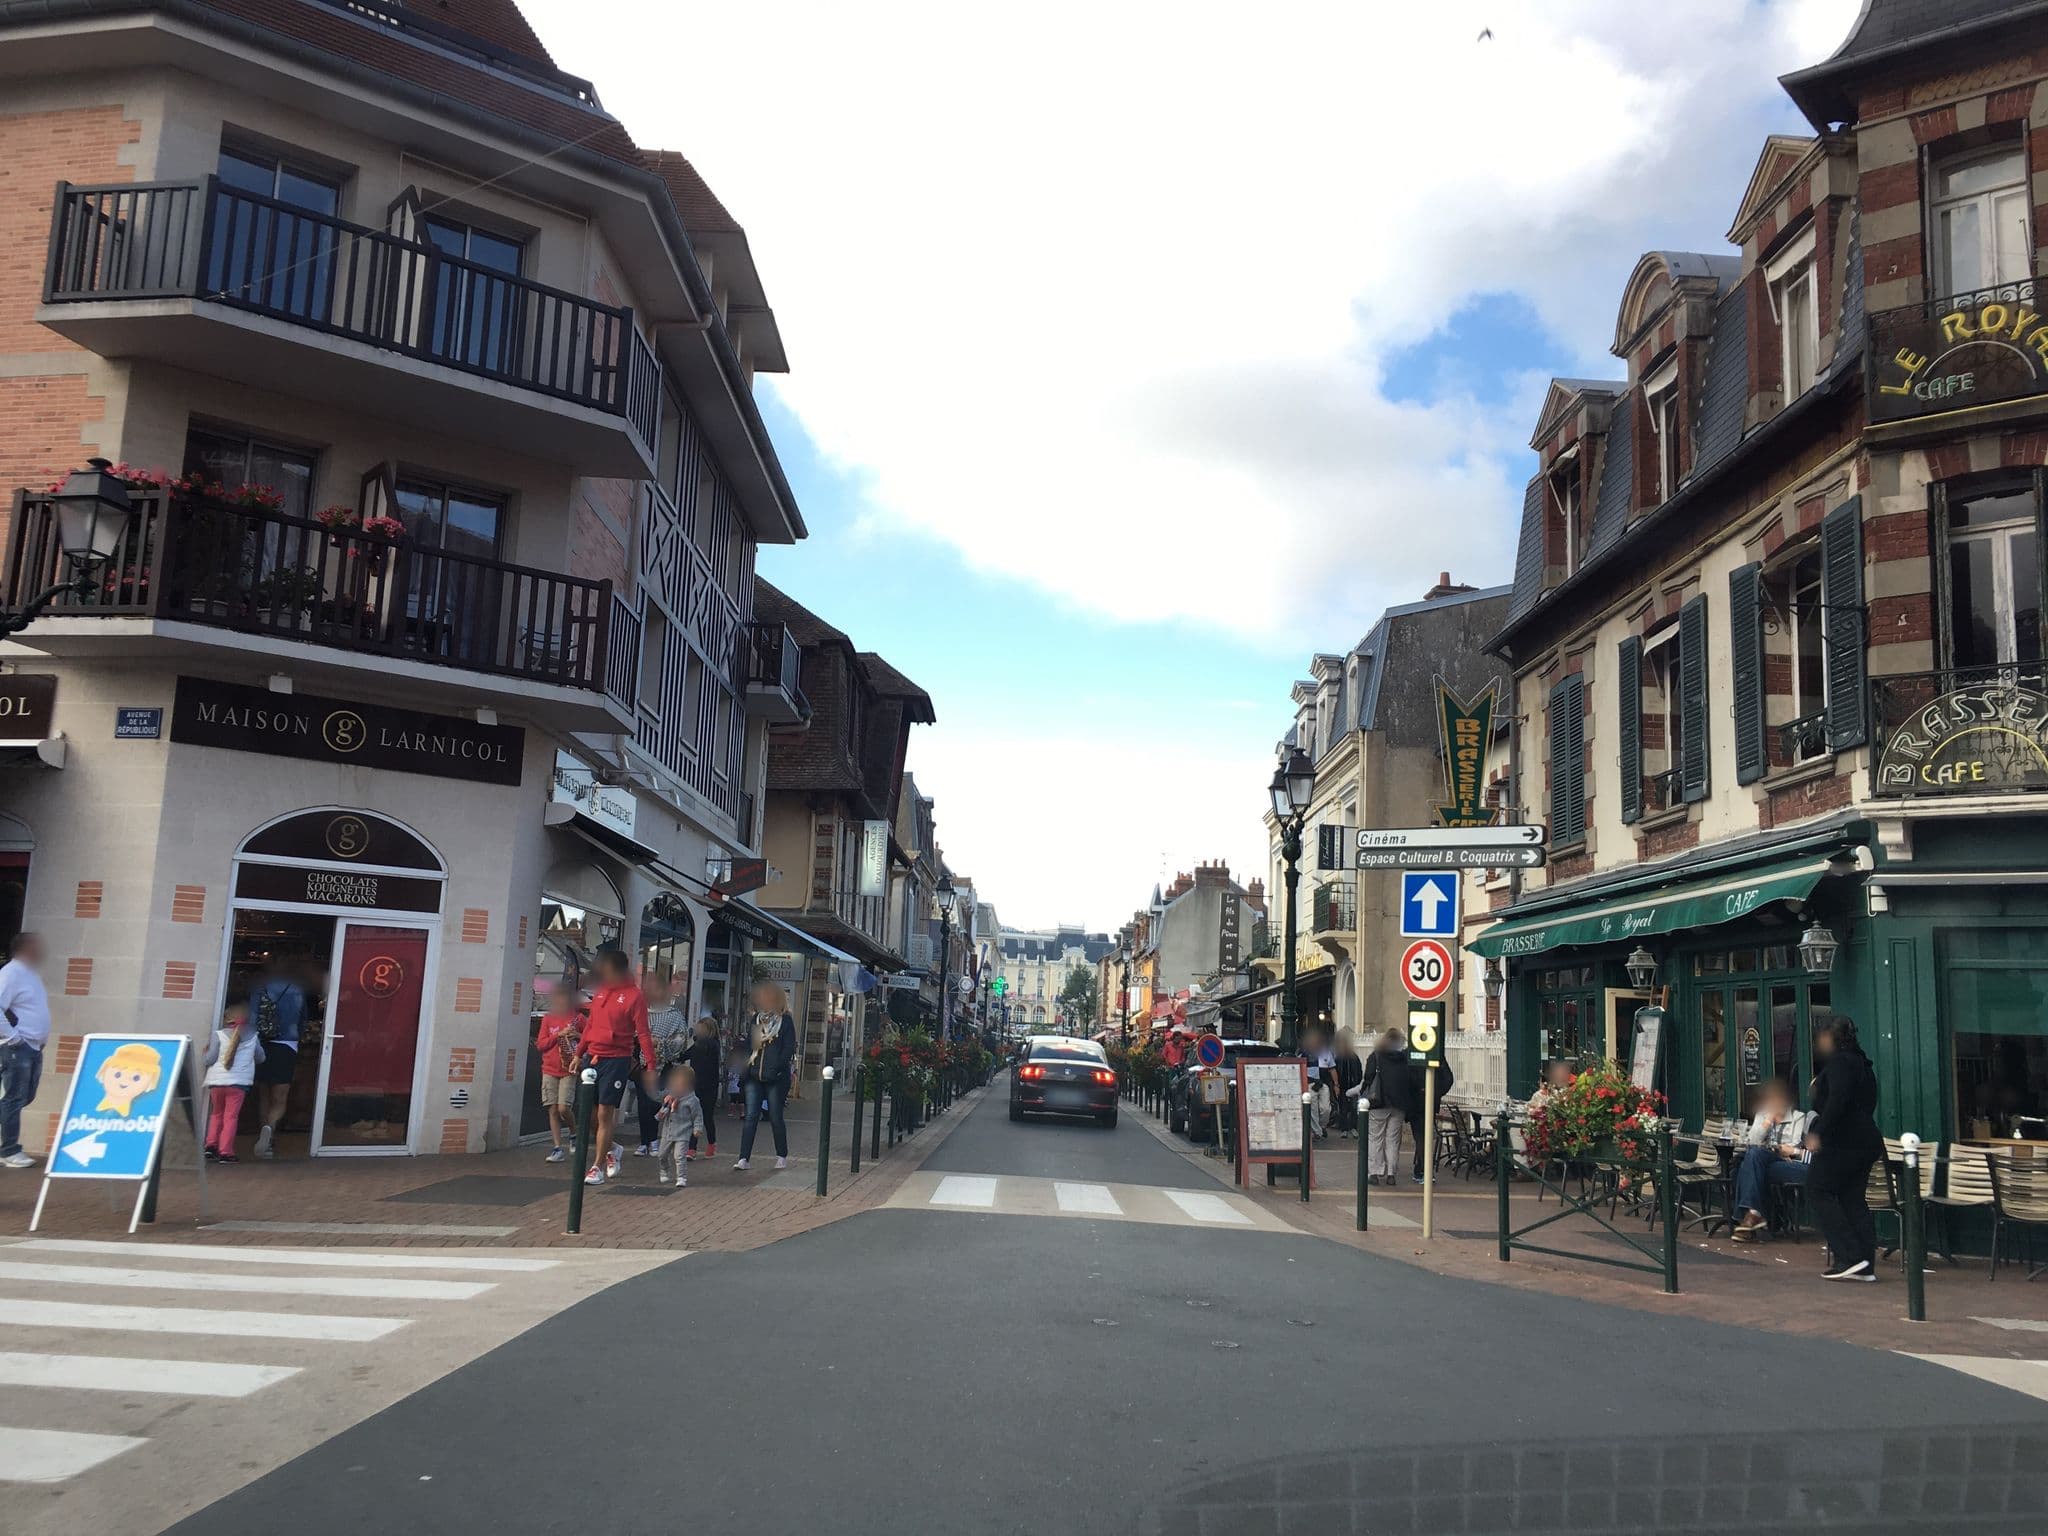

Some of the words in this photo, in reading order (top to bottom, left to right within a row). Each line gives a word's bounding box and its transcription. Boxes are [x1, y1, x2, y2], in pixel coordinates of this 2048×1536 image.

[1879, 347, 1927, 395] LE
[1914, 372, 1975, 400] CAFE
[117, 725, 158, 734] RÉPUBLIQUE
[196, 702, 311, 735] MAISON
[379, 727, 506, 763] LARNICOL
[1455, 718, 1481, 816] BRASSERIE
[1922, 761, 1986, 786] CAFE
[869, 825, 878, 861] AGENCES
[1360, 833, 1407, 846] Cinéma
[1359, 852, 1396, 867] Espace
[1398, 851, 1443, 864] Culturel
[1445, 850, 1456, 863] B.
[1460, 850, 1516, 866] Coquatrix
[306, 881, 377, 896] KOUIGNETTES
[307, 872, 378, 888] CHOCOLATS
[306, 891, 376, 905] MACARONS
[1412, 958, 1442, 982] 30
[64, 1113, 161, 1135] playmobil
